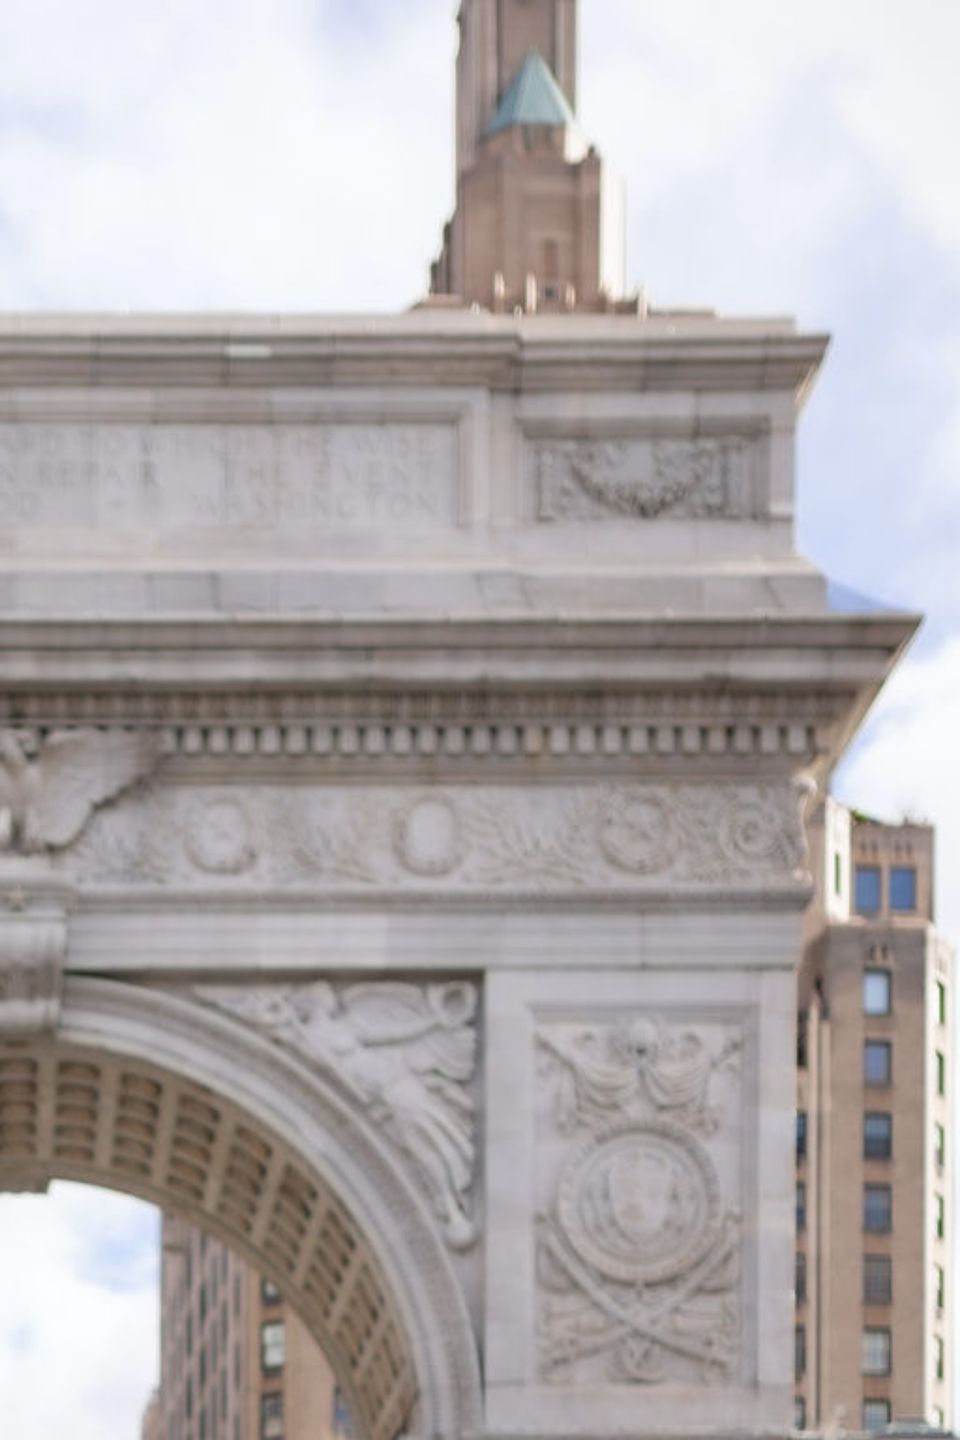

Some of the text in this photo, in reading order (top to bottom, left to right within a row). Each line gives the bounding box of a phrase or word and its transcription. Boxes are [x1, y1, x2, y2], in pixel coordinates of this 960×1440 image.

[221, 460, 291, 488] THE
[313, 461, 433, 488] EVENT
[191, 492, 438, 519] WASHINGTON
